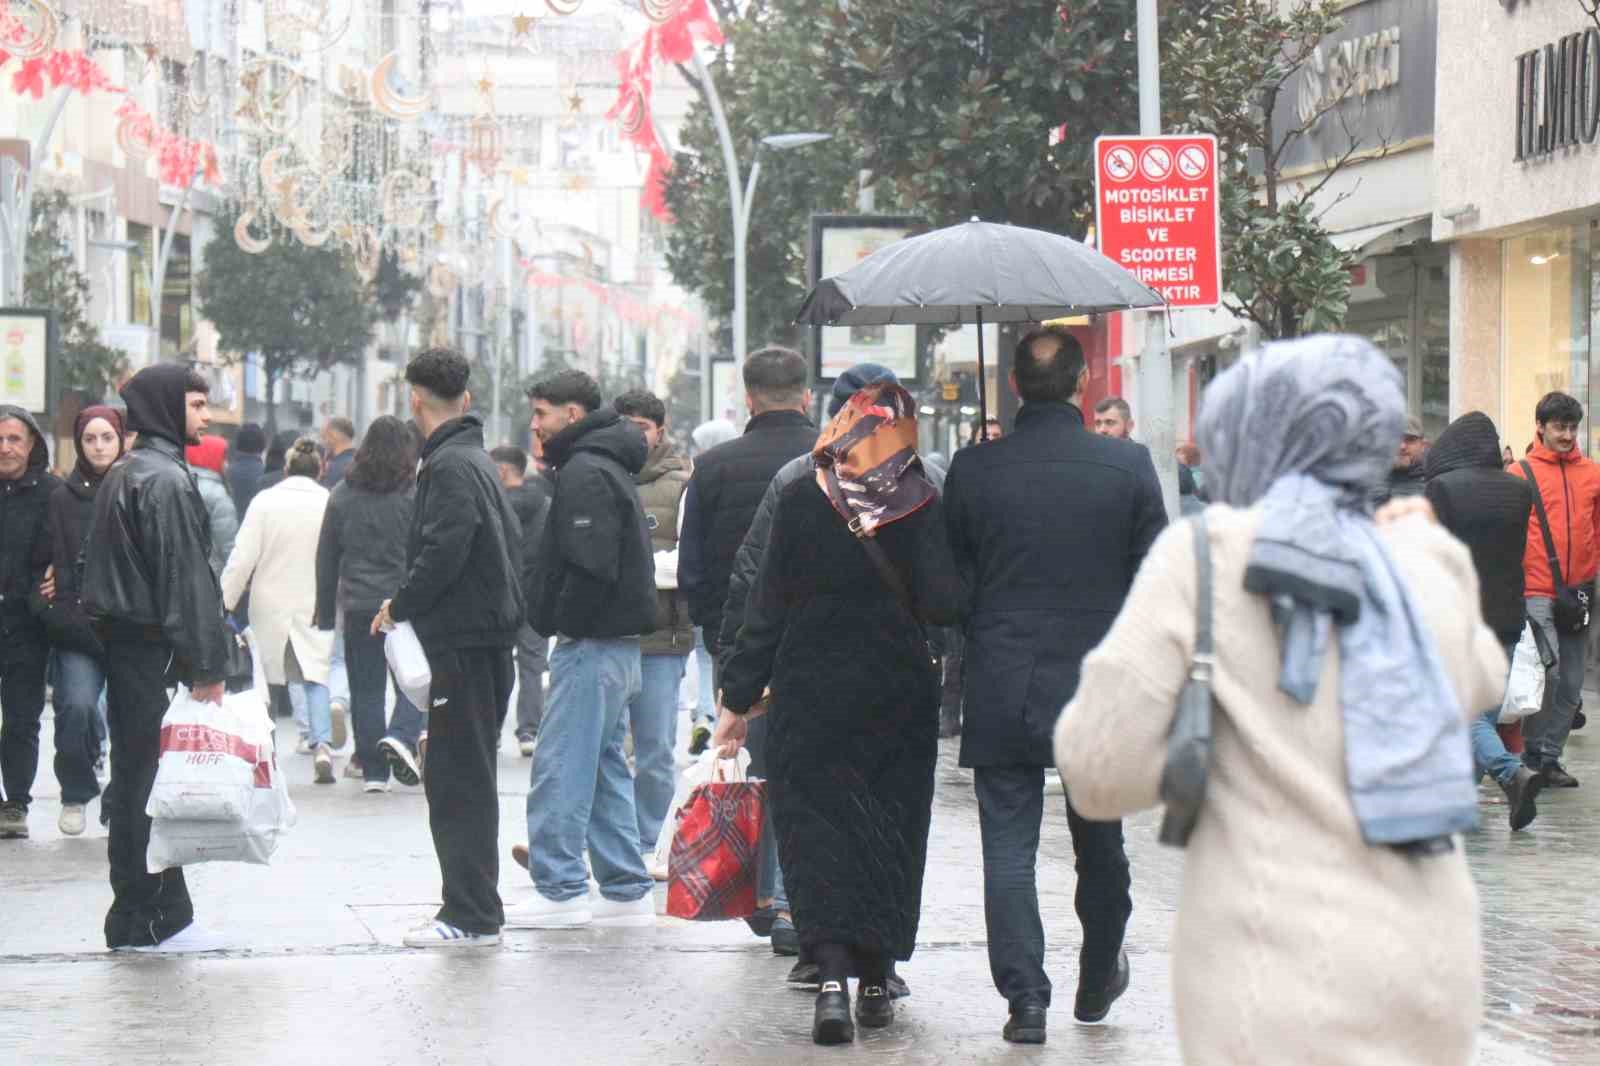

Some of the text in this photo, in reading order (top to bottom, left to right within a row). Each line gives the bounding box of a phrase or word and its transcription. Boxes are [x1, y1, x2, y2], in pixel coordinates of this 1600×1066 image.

[1105, 186, 1208, 204] MOTOSİKLET
[1120, 205, 1195, 223] BİSİKLET
[1147, 228, 1168, 242] VE
[1120, 247, 1197, 262] SCOOTER
[1154, 285, 1200, 300] KTIR
